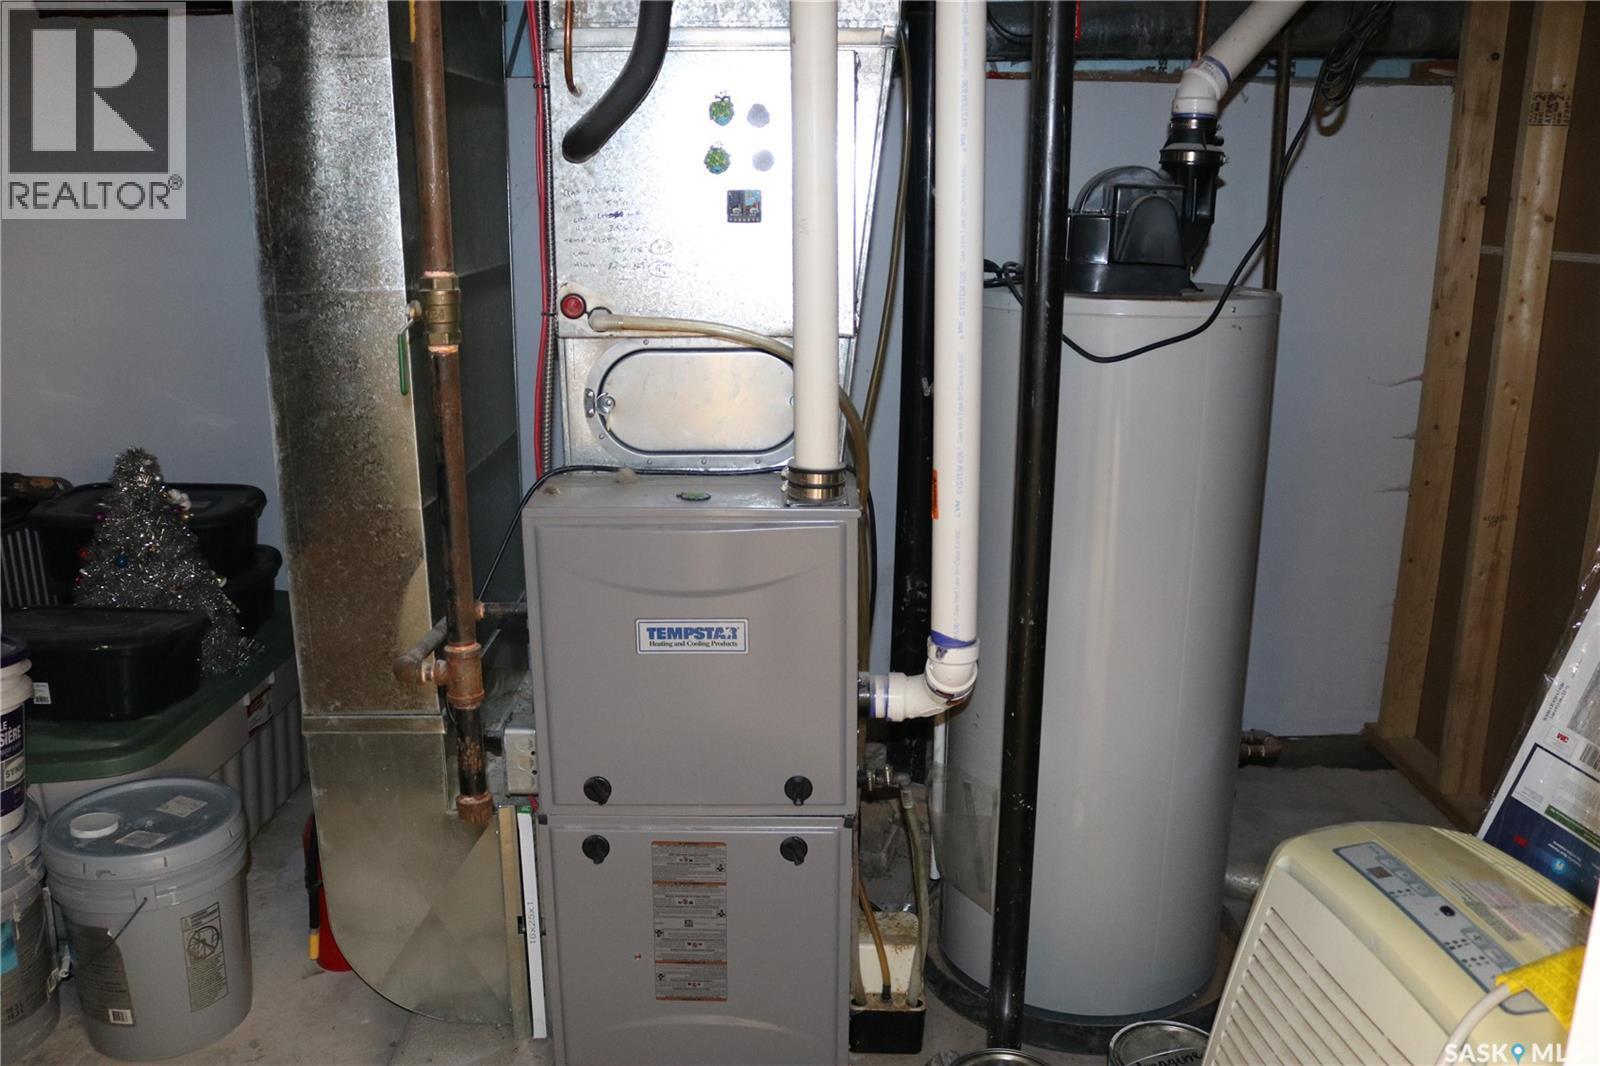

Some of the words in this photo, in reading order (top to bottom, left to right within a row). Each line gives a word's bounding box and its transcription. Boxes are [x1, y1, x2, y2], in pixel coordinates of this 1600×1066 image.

[649, 640, 673, 648] Heating
[687, 640, 710, 648] Cooling
[527, 902, 537, 943] 16x25x1
